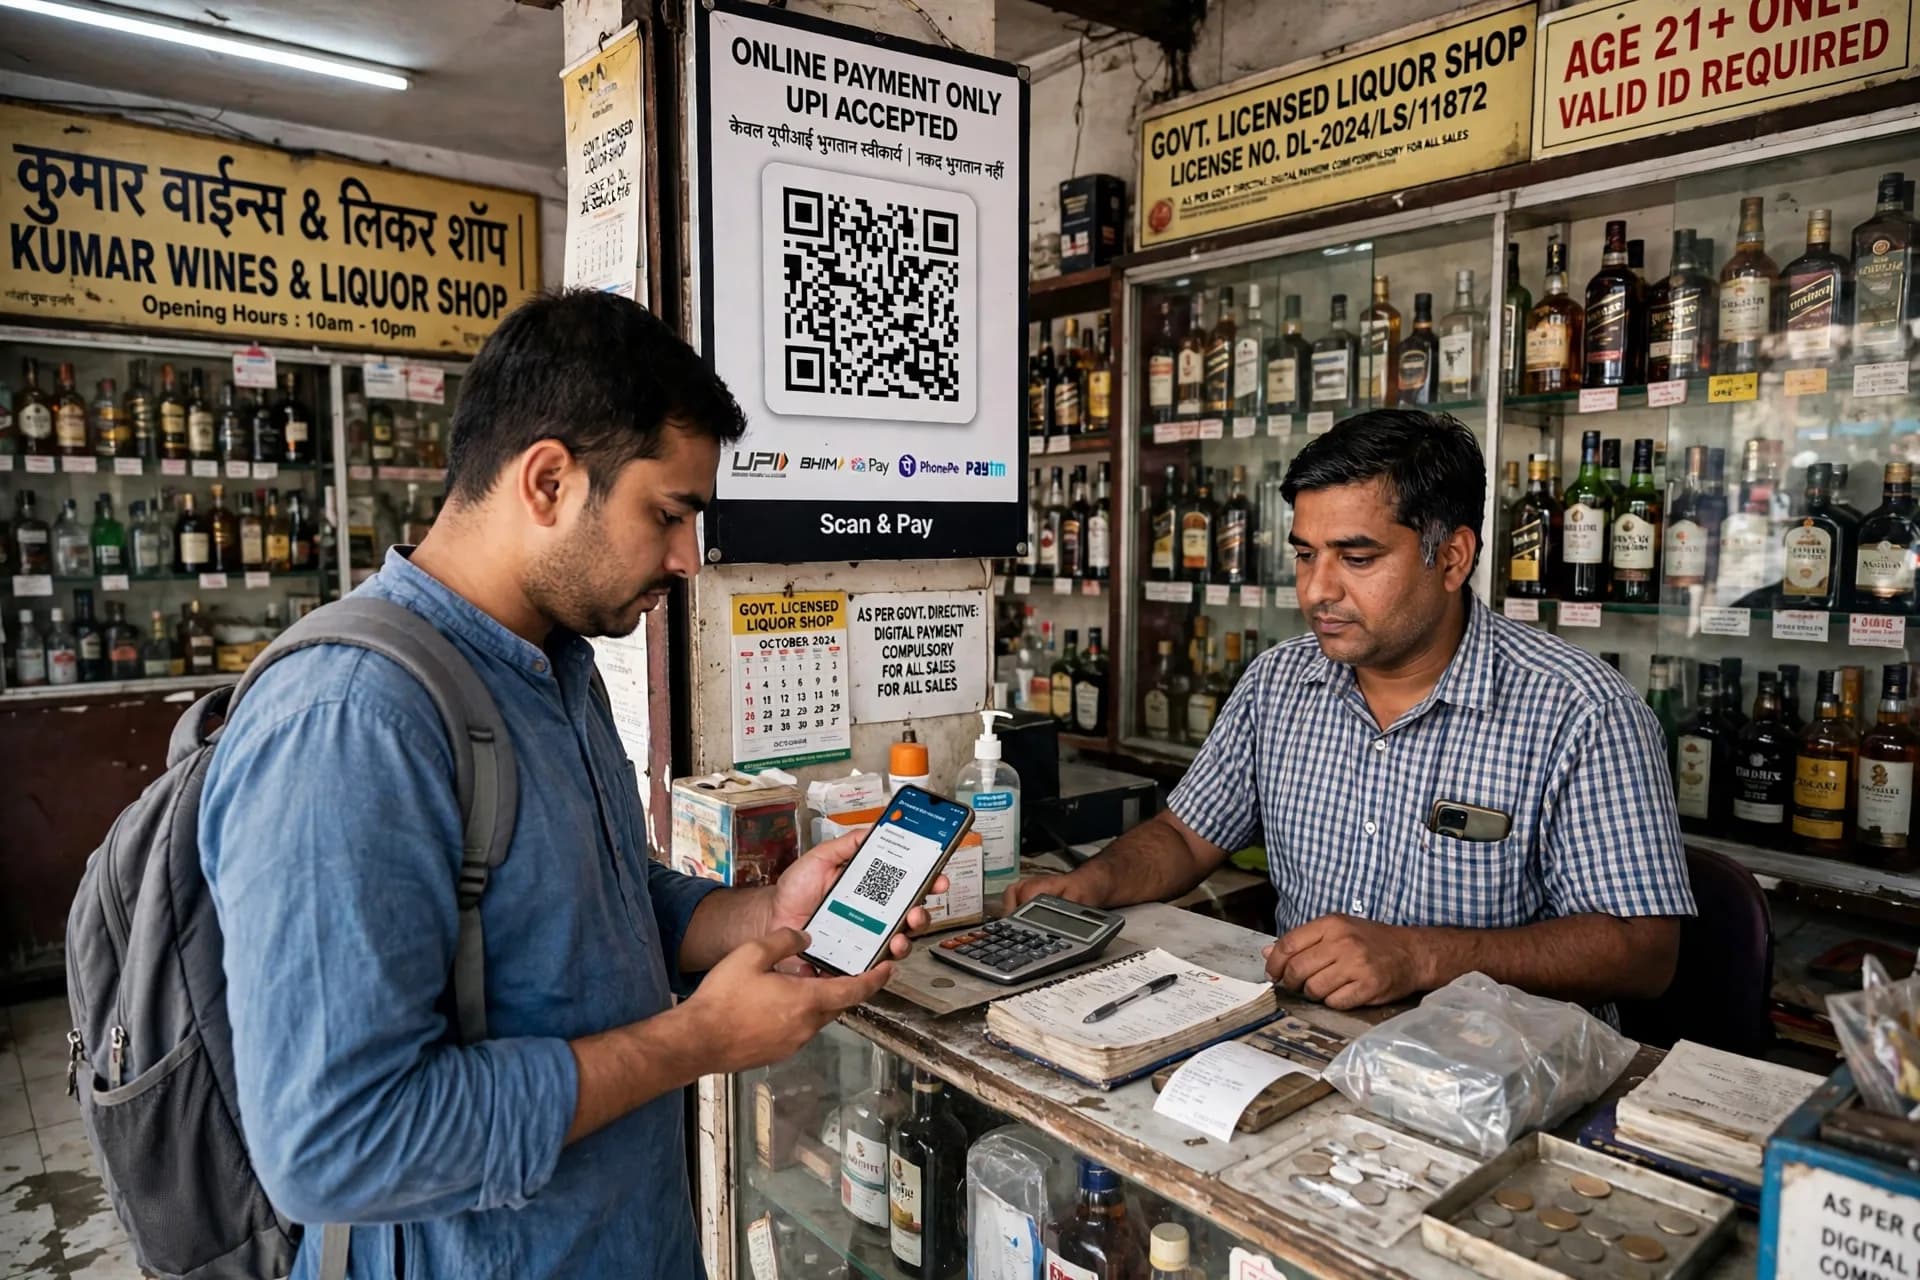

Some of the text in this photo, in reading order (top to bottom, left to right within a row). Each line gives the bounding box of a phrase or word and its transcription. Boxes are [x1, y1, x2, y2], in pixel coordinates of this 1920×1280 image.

[1564, 0, 1858, 83] AGE 21+ ONL
[731, 37, 1002, 116] ONLINE PAYMENT ONLY
[1559, 18, 1889, 129] VALID ID REQUIRED
[1151, 24, 1528, 160] GOVT. LICENSED LIQUOR SHOP
[786, 85, 958, 142] UPI ACCEPTED
[1170, 82, 1487, 187] LICENSE NO. DL-2024/LS/11872
[1424, 137, 1440, 149] ALL
[1442, 129, 1469, 145] SALES
[728, 114, 764, 139] केवल
[767, 124, 814, 150] यूपीआई
[817, 134, 857, 156] भुगतान
[860, 140, 903, 162] स्वीकार्य
[915, 151, 943, 171] नकद
[945, 155, 982, 176] भुगतान
[984, 160, 1004, 179] नहीं
[12, 143, 508, 266] कुमार वाईन्स & लिकर शॉप
[11, 223, 508, 320] KUMAR WINES & LIQUOR SHOP
[142, 294, 227, 326] Opening
[232, 307, 288, 328] Hours
[306, 312, 353, 332] 10am
[370, 316, 416, 339] 10pm
[732, 452, 781, 471] UPI
[800, 457, 838, 471] BHIM
[868, 458, 890, 477] Pay
[920, 461, 960, 474] PhonePe
[820, 513, 933, 538] Scan & Pay
[740, 600, 839, 616] GOVT. LICENSED
[857, 604, 979, 621] AS PER GOVT. DIRECTIVE:
[747, 615, 834, 632] LIQUOR SHOP
[874, 624, 964, 640] DIGITAL PAYMENT
[759, 636, 836, 649] OCTOBER 2024
[882, 642, 954, 659] COMPULSORY
[882, 660, 956, 678] FOR ALL SALES
[878, 678, 958, 697] FOR ALL SALES
[1823, 1192, 1851, 1217] AS
[1860, 1204, 1904, 1237] PER
[1822, 1227, 1908, 1275] DIGITAL
